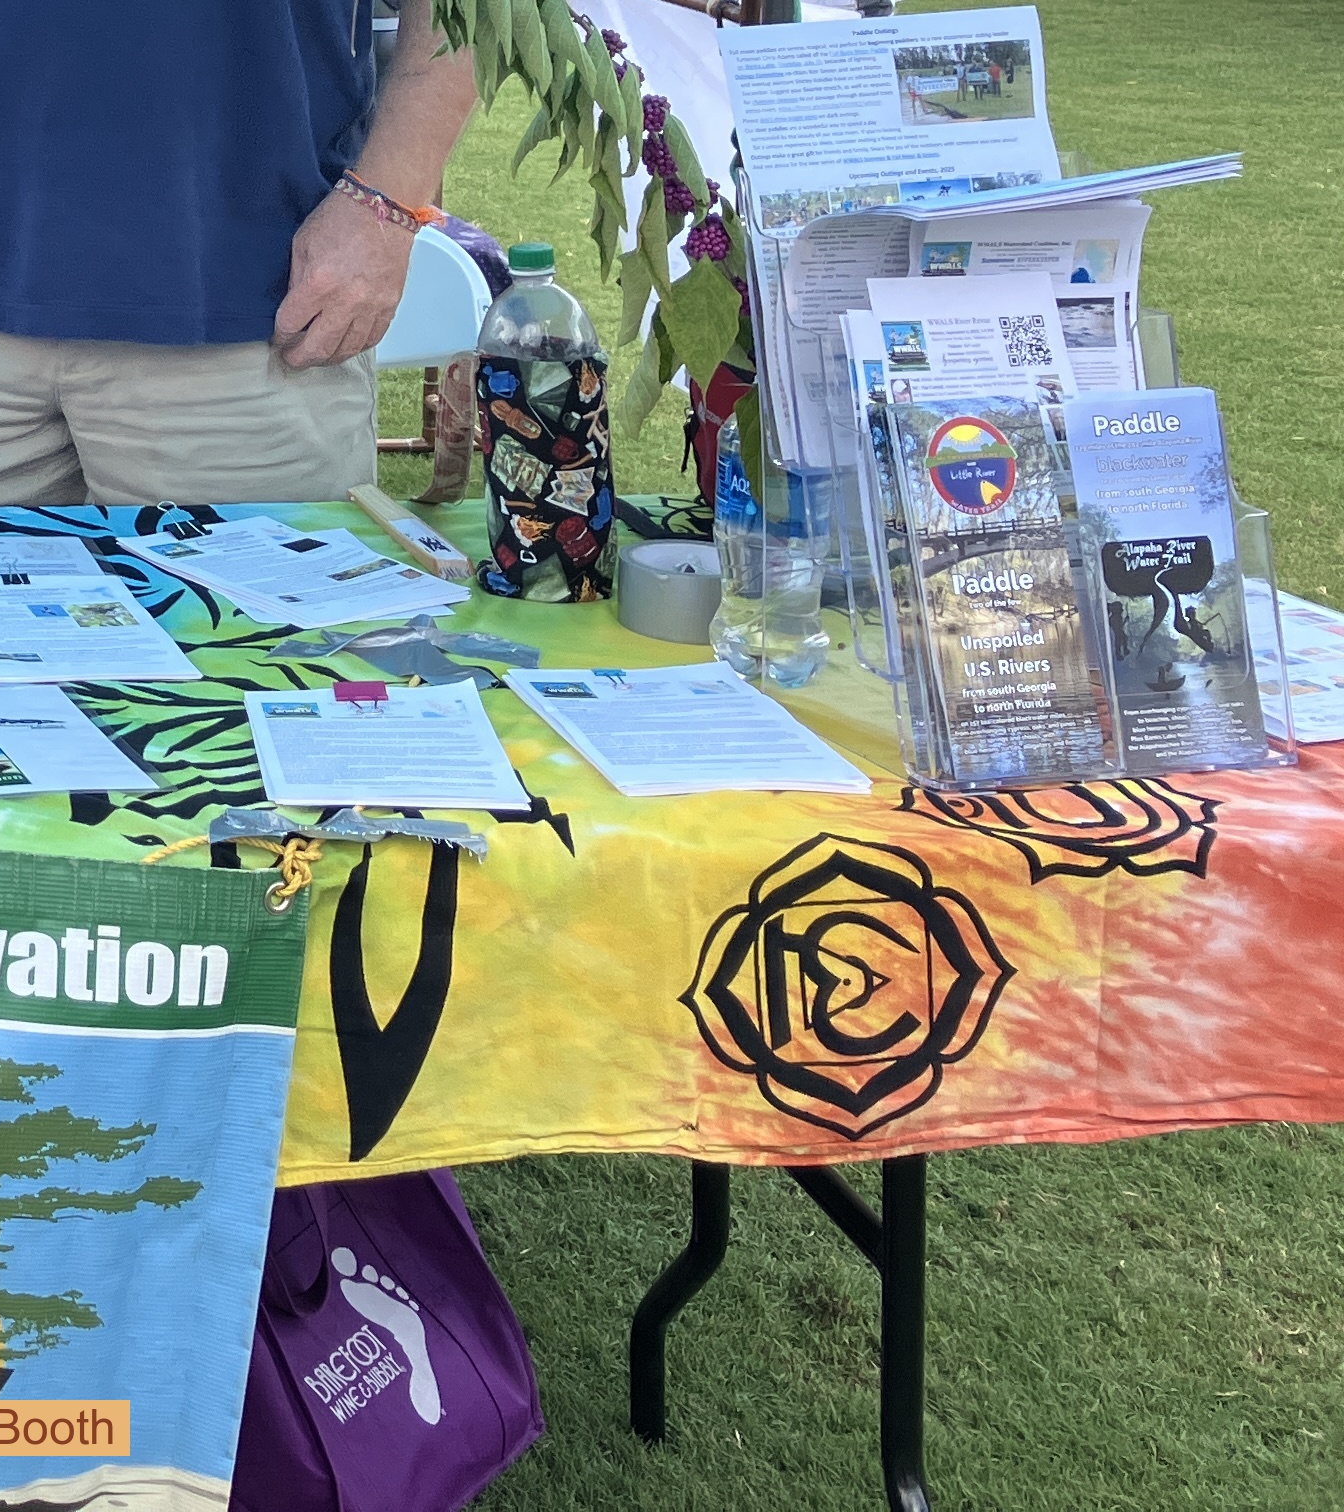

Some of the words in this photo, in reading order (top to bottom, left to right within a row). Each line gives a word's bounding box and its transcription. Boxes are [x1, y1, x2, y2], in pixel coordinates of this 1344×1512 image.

[1092, 411, 1180, 437] Paddle
[1096, 452, 1188, 474] blackwater
[950, 468, 973, 480] Little
[1096, 489, 1120, 499] from
[1124, 486, 1152, 497] south
[1154, 484, 1195, 496] Georgia
[951, 499, 979, 514] WATER
[1108, 506, 1119, 514] to
[1121, 502, 1149, 513] north
[1115, 542, 1163, 558] Alapaha
[1167, 540, 1196, 554] River
[1124, 557, 1159, 571] Water
[1161, 553, 1192, 568] Trail
[951, 569, 1034, 595] Paddle
[960, 629, 1044, 652] Unspoiled
[964, 661, 996, 677] U.S.
[998, 659, 1051, 675] Rivers
[963, 688, 986, 698] from
[987, 684, 1015, 696] south
[1016, 681, 1057, 696] Georgia
[974, 704, 985, 713] to
[987, 701, 1014, 712] north
[303, 1324, 387, 1404] BAREFOOT
[329, 1385, 367, 1424] WINE
[362, 1351, 407, 1395] BUBBLY
